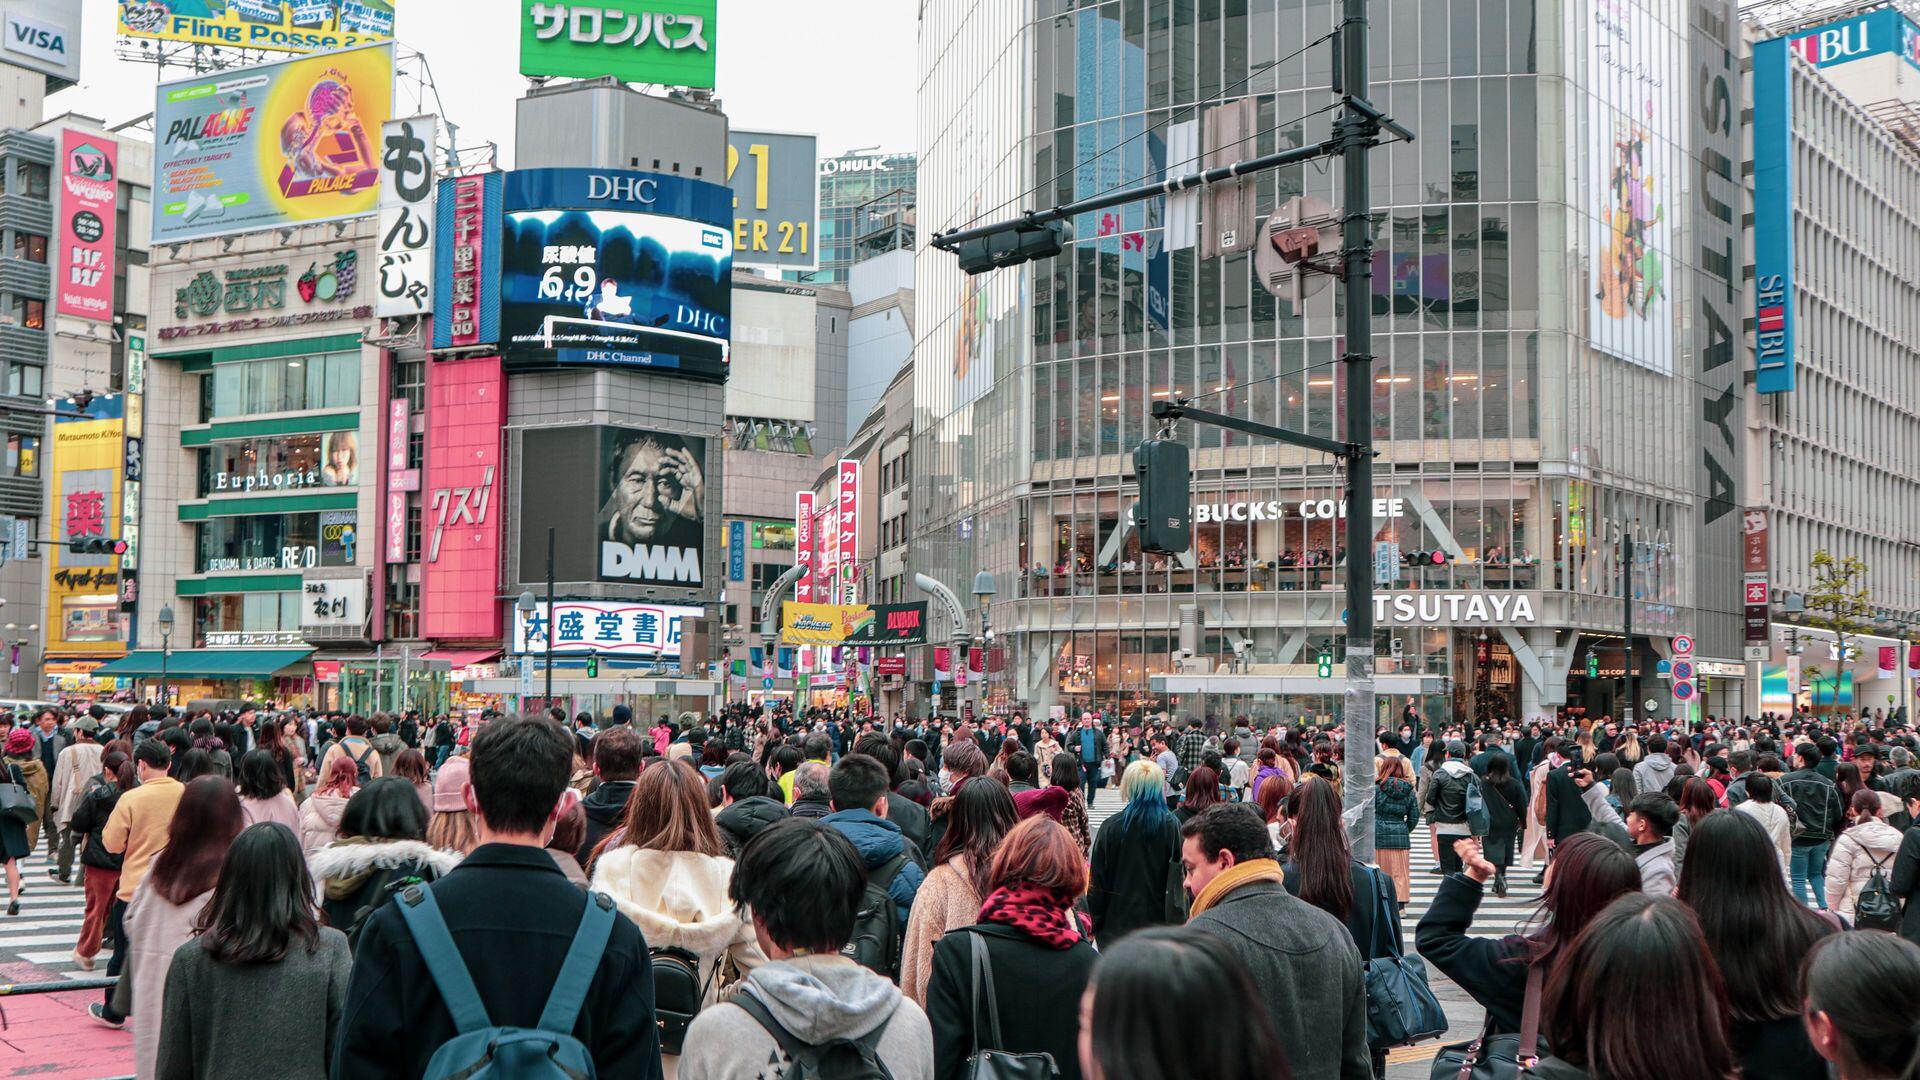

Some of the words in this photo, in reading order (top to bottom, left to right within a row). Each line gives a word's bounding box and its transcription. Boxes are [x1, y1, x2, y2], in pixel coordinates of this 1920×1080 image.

[228, 0, 279, 21] Phantom
[294, 11, 322, 25] easy
[325, 9, 334, 19] R
[341, 16, 361, 28] Dead
[10, 21, 65, 55] VISA
[173, 17, 242, 42] Fling
[250, 25, 338, 47] Posse
[530, 2, 708, 52] サロンパス
[1800, 20, 1871, 62] IBU
[307, 174, 356, 194] PALACE
[587, 175, 657, 204] DHC
[383, 121, 432, 310] もんじゃ
[703, 233, 723, 246] DHC
[777, 221, 808, 254] 21
[72, 246, 102, 266] B1F
[452, 181, 478, 336] 三千里薬品
[1699, 3, 1735, 526] TSUTAYA
[71, 266, 103, 287] B2F
[225, 278, 286, 312] 西村
[676, 305, 725, 334] DHC
[1759, 274, 1785, 372] SEIBU
[586, 350, 611, 362] DHC
[612, 353, 652, 364] Channel
[57, 432, 100, 442] Matsumoto
[216, 468, 316, 493] Euphoria
[66, 490, 104, 536] 薬
[428, 465, 495, 562] クスリ
[841, 471, 855, 543] カラオケ
[1127, 501, 1282, 526] BUCKS
[1299, 499, 1404, 519] COEE
[254, 557, 276, 569] DARTS
[282, 546, 316, 569] RE/D
[602, 542, 702, 582] DMM
[305, 583, 327, 594] うなぎ
[1748, 585, 1765, 600] 本
[887, 610, 920, 630] ALVARK
[1372, 594, 1535, 622] TSUTAYA
